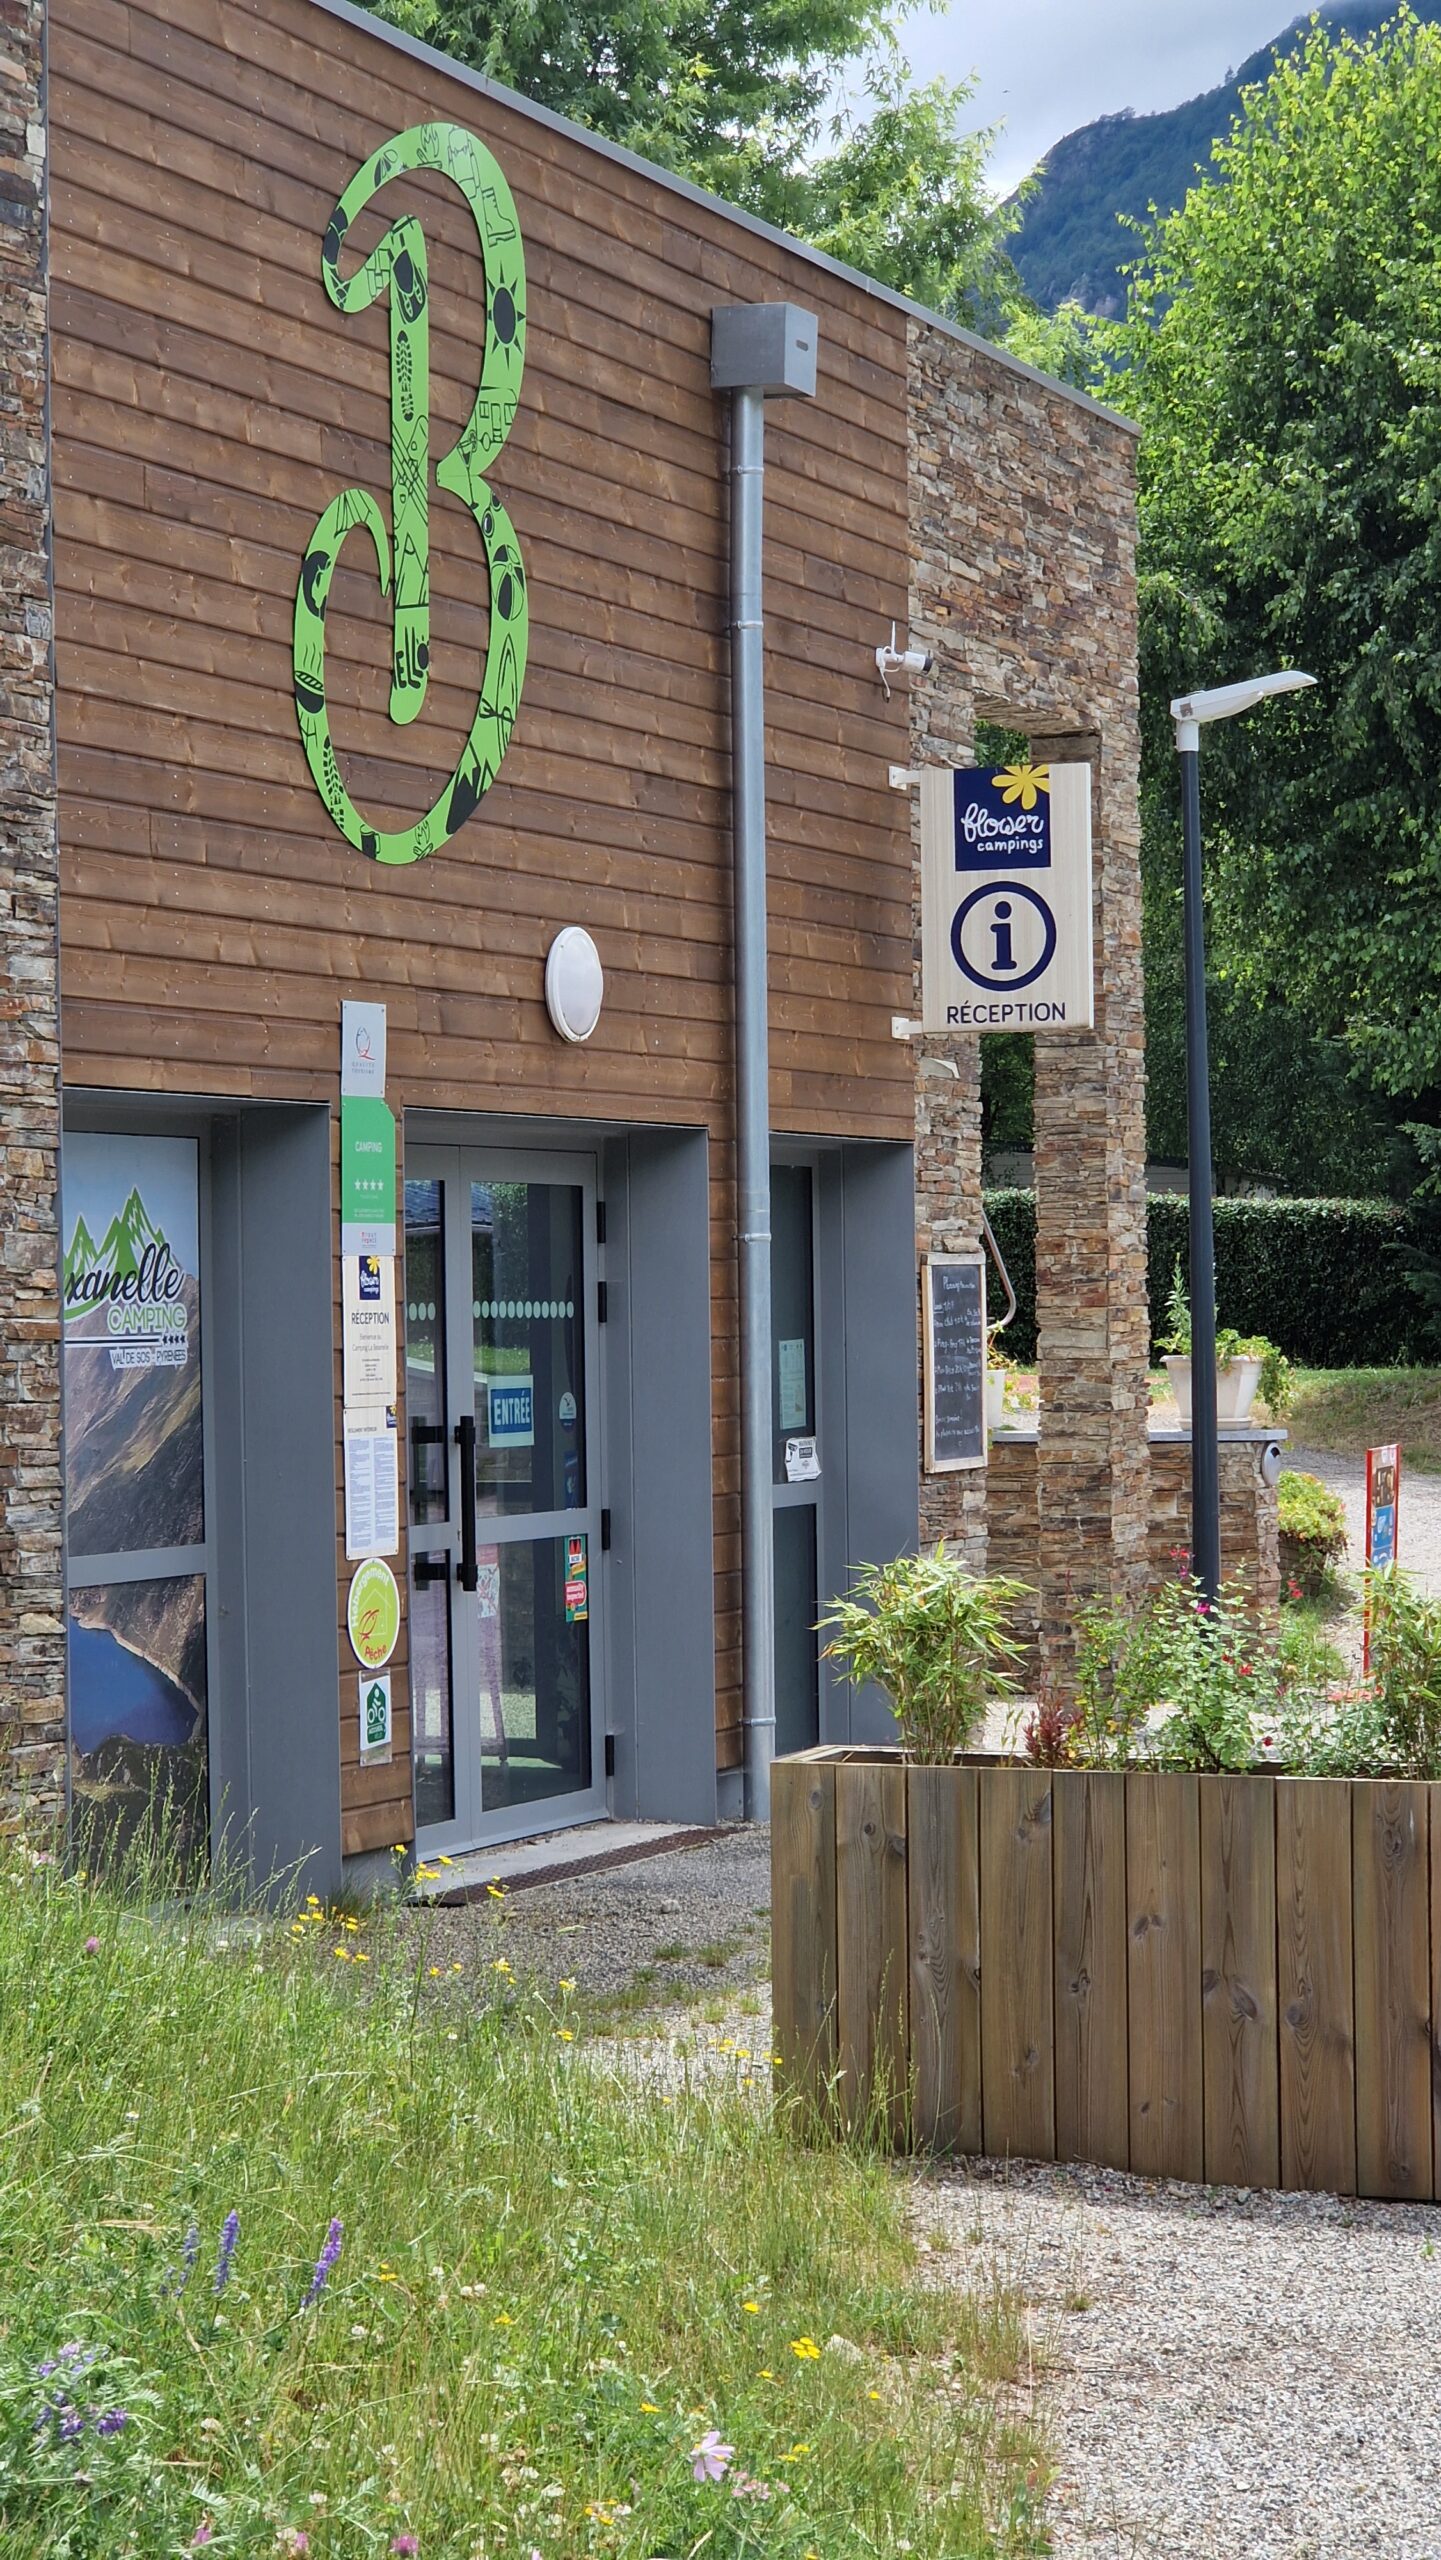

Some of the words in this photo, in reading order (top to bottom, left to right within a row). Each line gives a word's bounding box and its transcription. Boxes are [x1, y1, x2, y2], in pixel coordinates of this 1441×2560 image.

[960, 802, 1045, 842] flower
[976, 837, 1044, 855] campings
[946, 1000, 1067, 1025] RÉCEPTION
[355, 1141, 383, 1153] CAMPING
[108, 1306, 186, 1332] CAMPING
[351, 1309, 390, 1325] RÉCEPTION
[126, 1351, 135, 1364] DE
[136, 1351, 150, 1363] SOS
[494, 1389, 530, 1426] ENTRÉE
